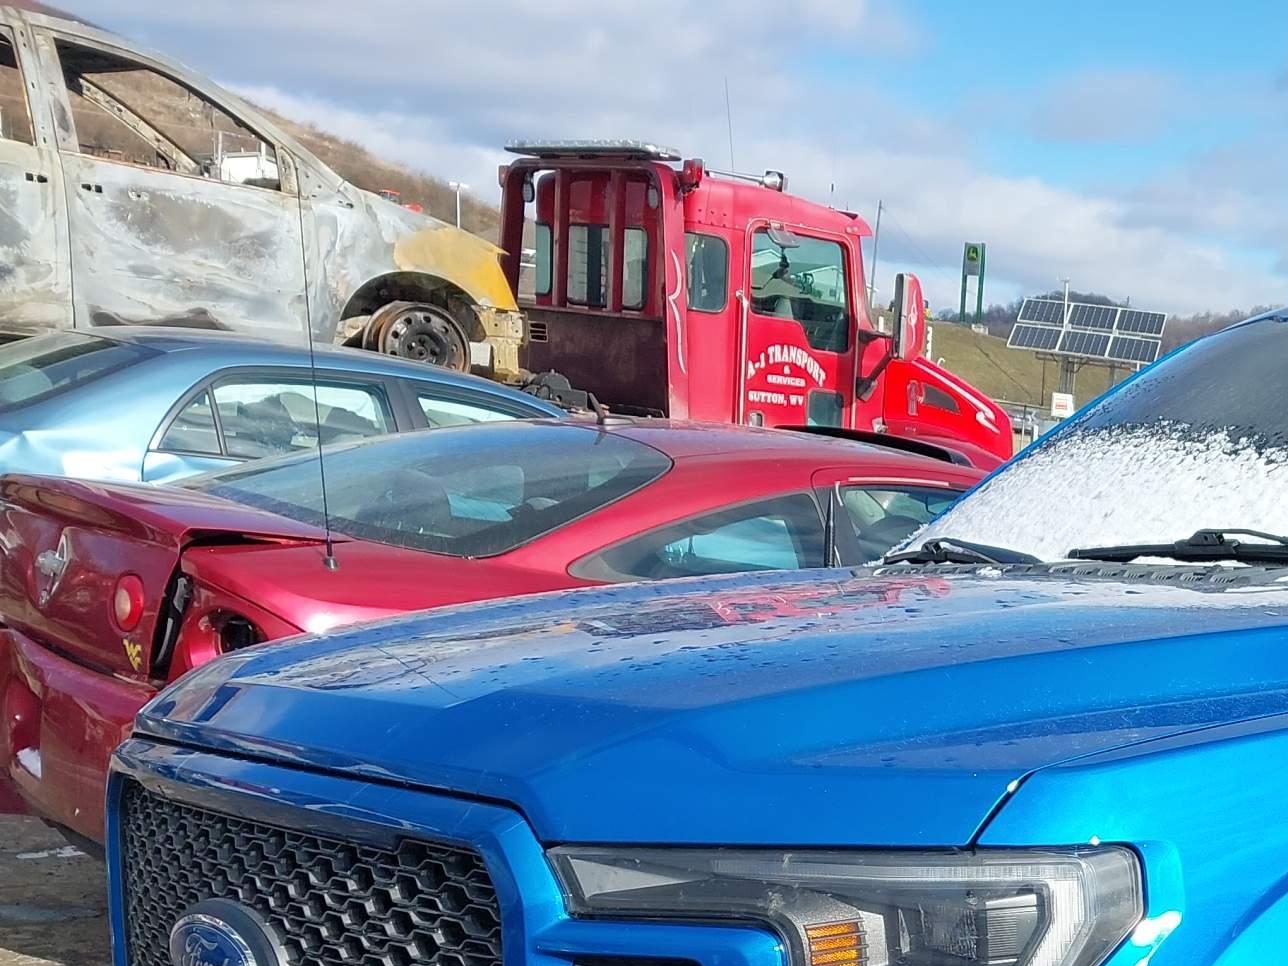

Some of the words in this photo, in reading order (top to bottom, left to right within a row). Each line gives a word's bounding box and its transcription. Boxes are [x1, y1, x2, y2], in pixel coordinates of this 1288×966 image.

[767, 344, 826, 388] TRANSPORT
[748, 390, 788, 407] SUTTON,
[789, 394, 804, 406] WV
